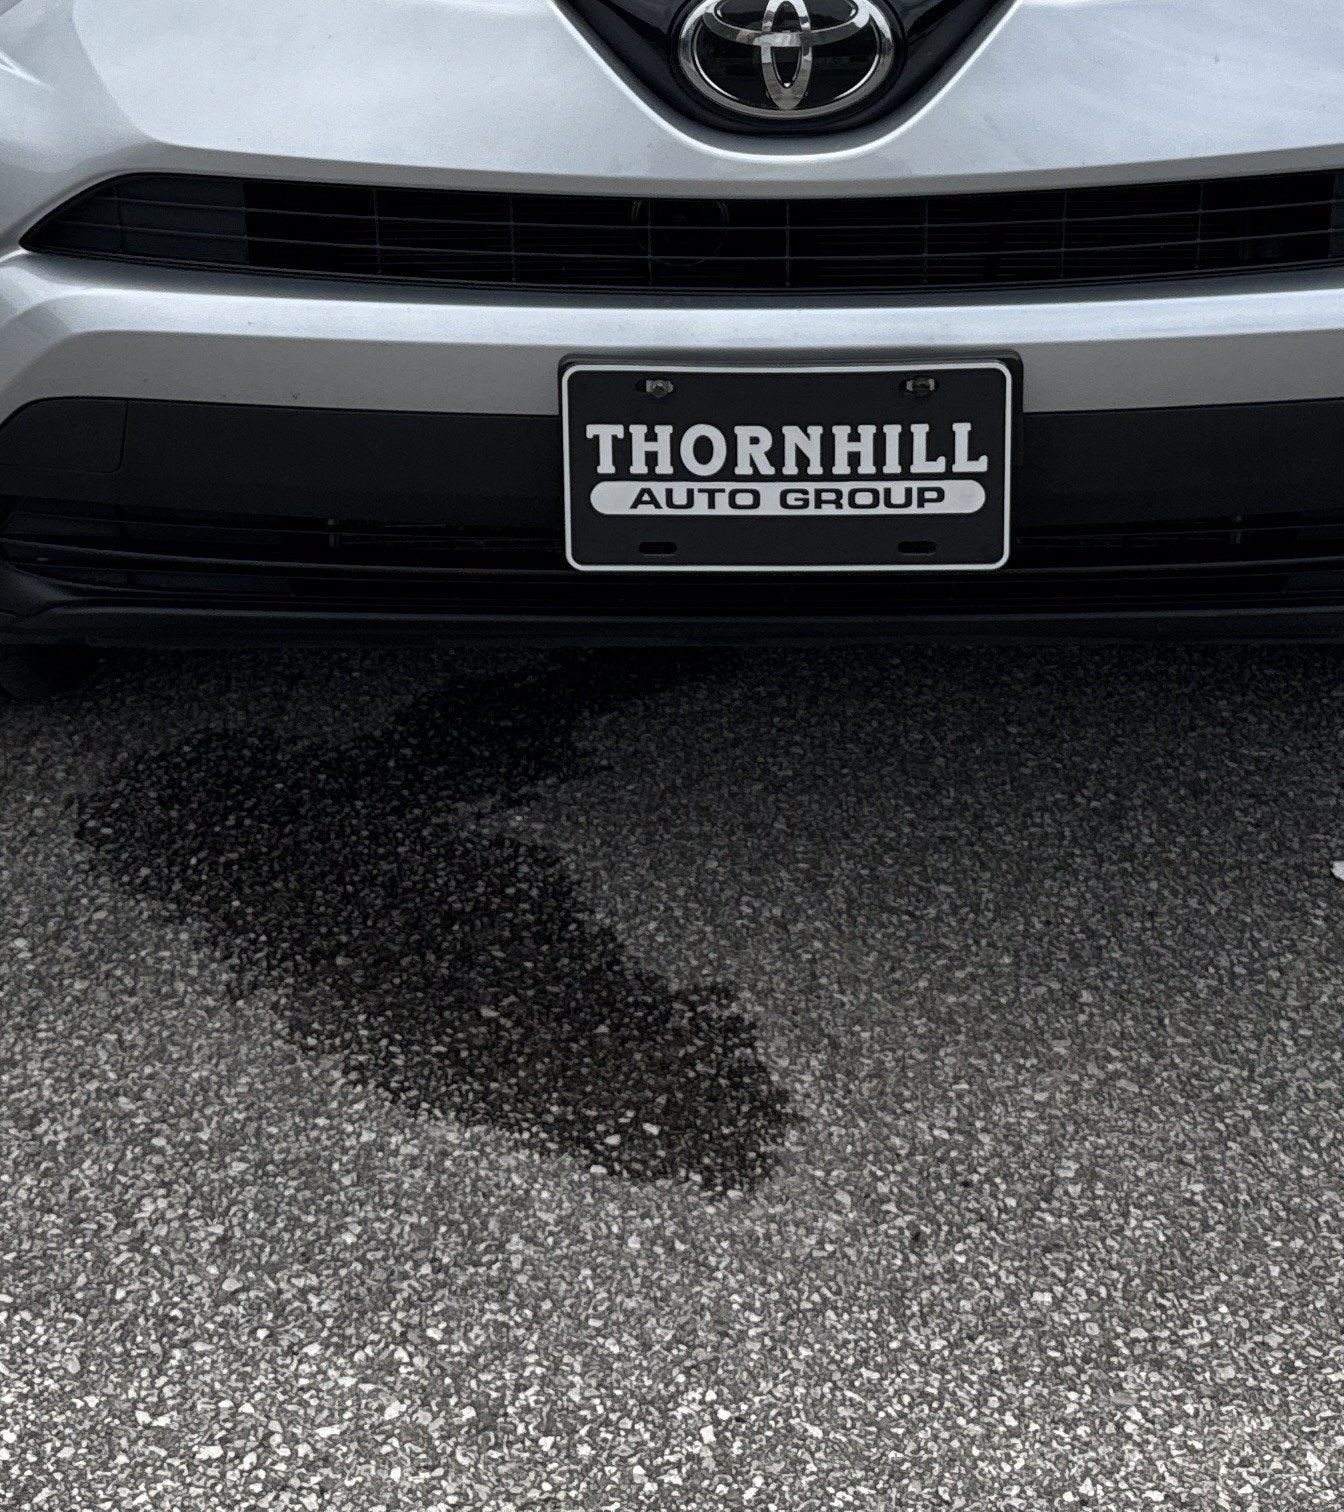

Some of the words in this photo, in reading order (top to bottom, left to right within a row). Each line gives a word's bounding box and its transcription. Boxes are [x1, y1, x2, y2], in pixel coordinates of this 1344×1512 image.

[585, 422, 988, 476] THORNHILL
[629, 487, 761, 510] AUTO
[779, 486, 946, 510] GROUP
